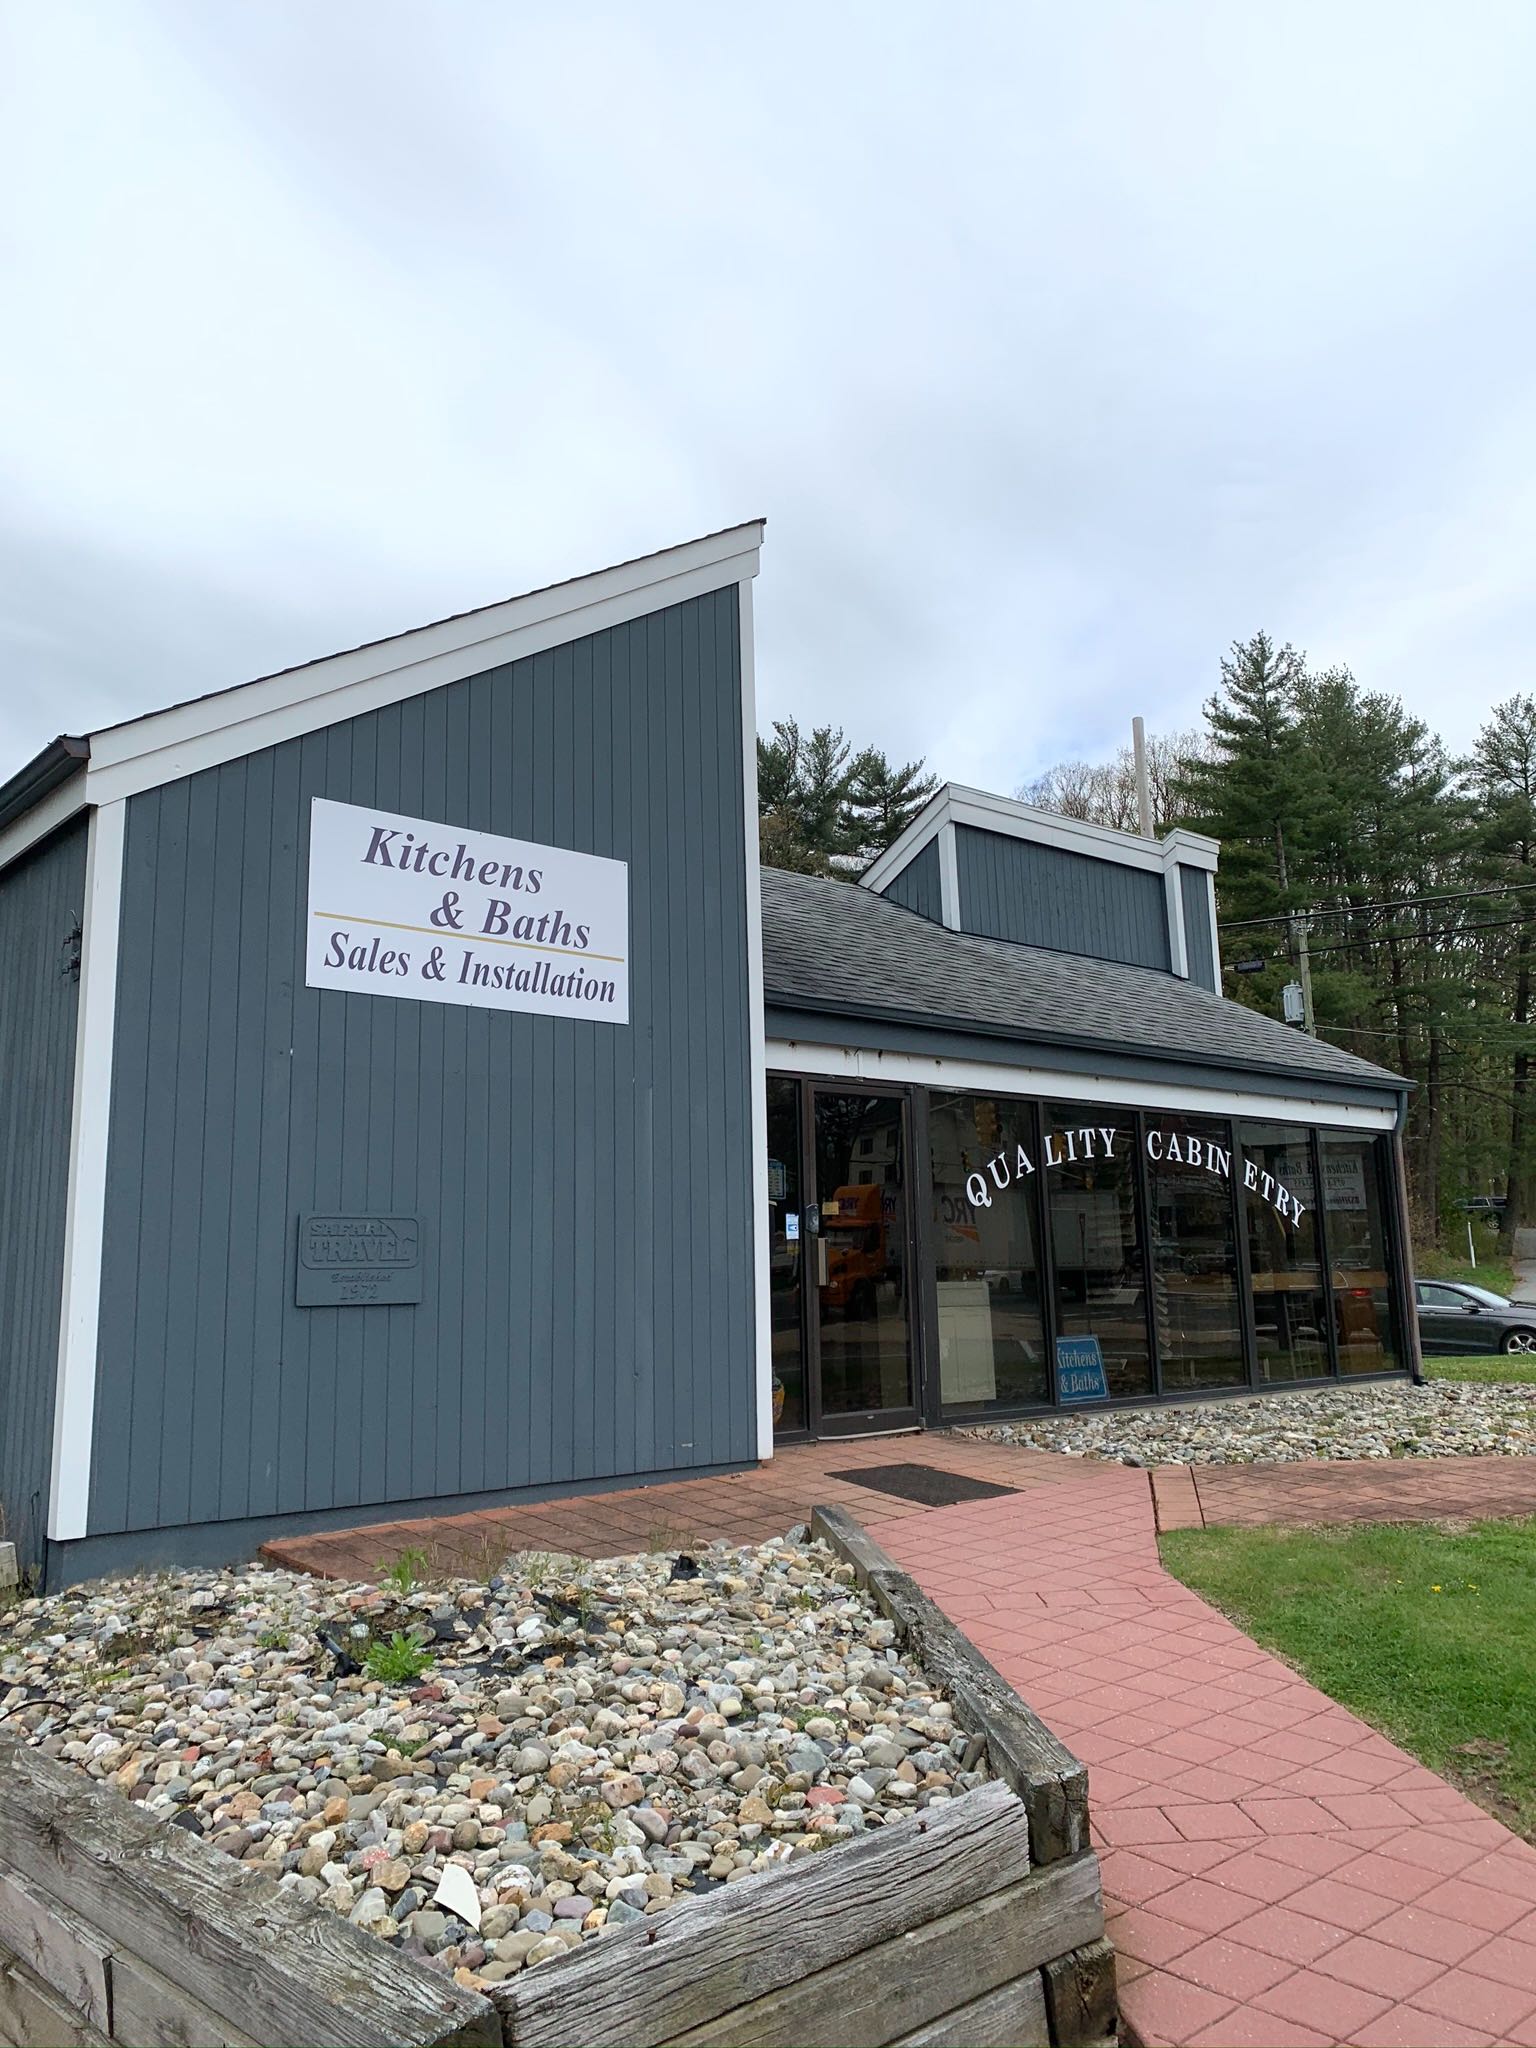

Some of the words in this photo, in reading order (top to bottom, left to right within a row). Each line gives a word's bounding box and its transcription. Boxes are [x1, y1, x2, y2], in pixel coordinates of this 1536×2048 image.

[360, 826, 544, 894] Kitchens
[429, 891, 465, 930] &
[478, 898, 591, 950] Baths
[324, 931, 411, 977] Sales
[421, 946, 447, 982] &
[457, 950, 616, 1003] Installation
[309, 1238, 411, 1262] TRAVEL
[310, 1223, 388, 1237] SAFARI
[1060, 1373, 1070, 1394] &
[1071, 1371, 1101, 1393] Baths
